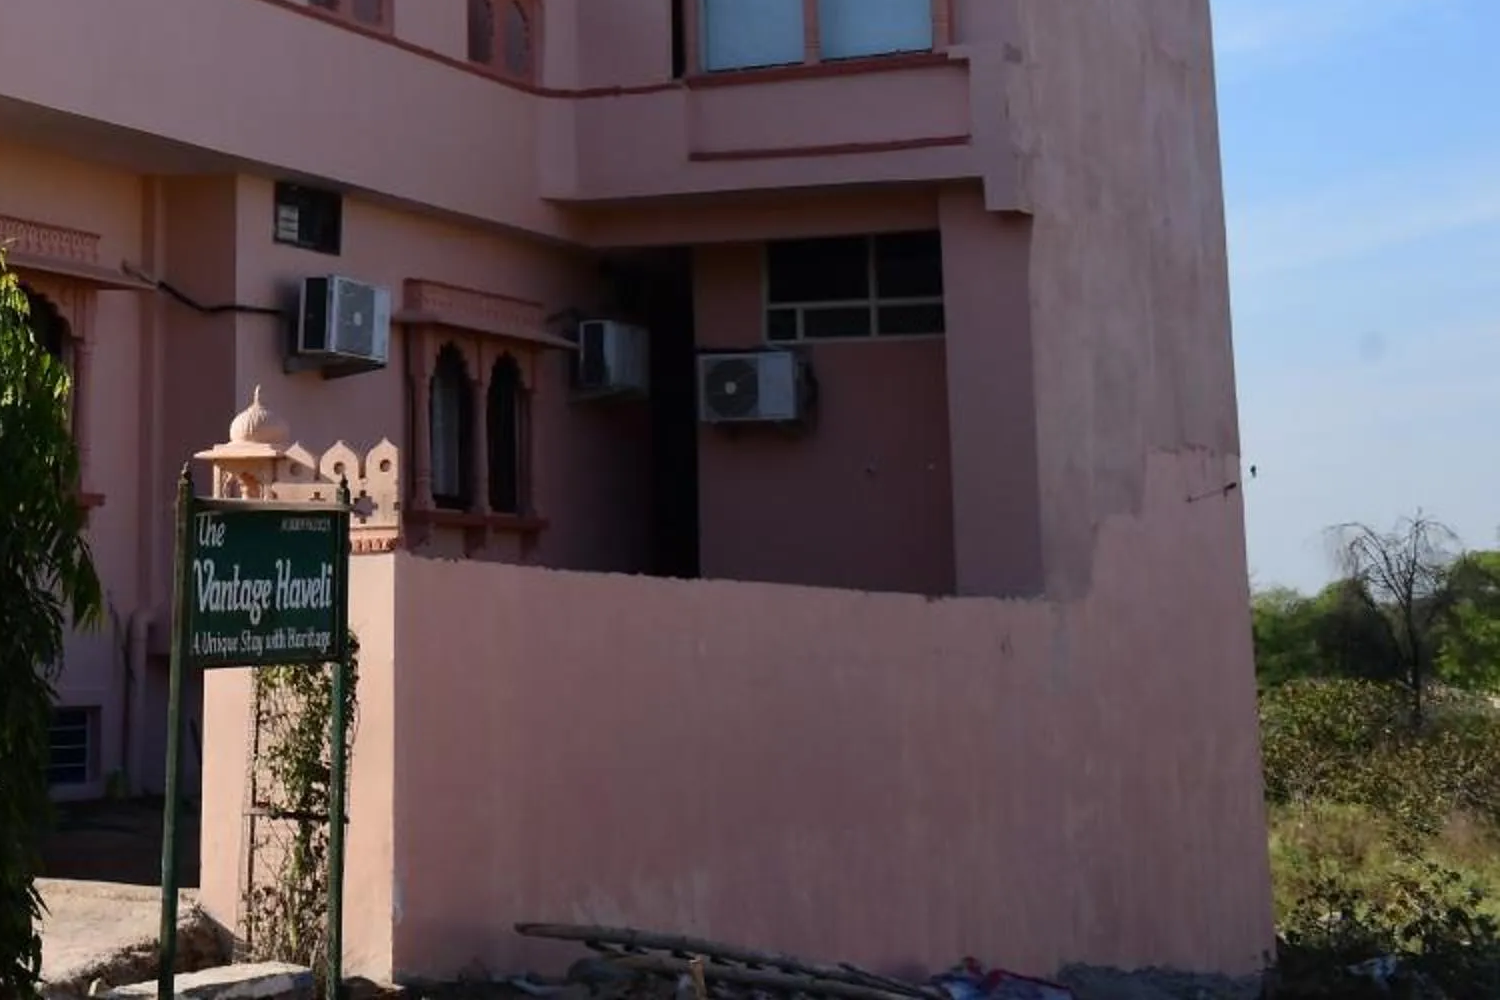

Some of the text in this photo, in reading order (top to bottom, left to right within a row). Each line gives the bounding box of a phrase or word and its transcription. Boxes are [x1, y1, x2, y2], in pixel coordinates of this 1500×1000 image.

[195, 512, 225, 547] The
[193, 557, 333, 626] Vantage Haveli
[202, 631, 239, 660] Unique
[240, 628, 264, 657] Stay
[265, 627, 287, 649] with
